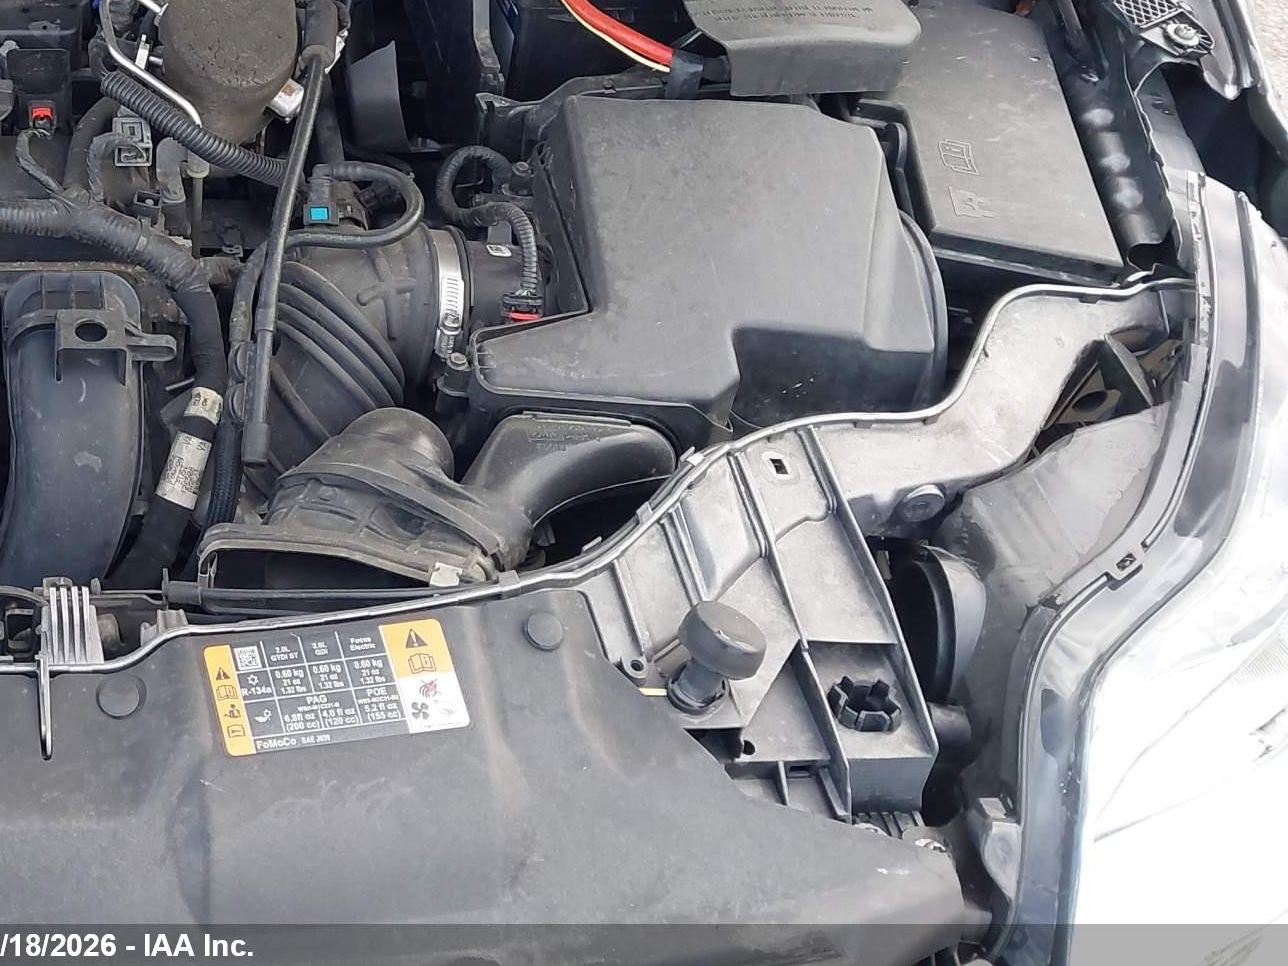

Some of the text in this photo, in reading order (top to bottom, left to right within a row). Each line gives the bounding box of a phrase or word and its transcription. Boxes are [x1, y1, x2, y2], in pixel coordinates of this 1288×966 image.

[275, 646, 290, 654] 2.0L
[350, 643, 376, 651] Electric
[271, 652, 298, 662] GTDI ST
[312, 664, 342, 674] 0.60 kg
[354, 659, 383, 669] 0.60 kg
[276, 669, 304, 679] 0.60 kg
[242, 686, 272, 697] R-134a
[367, 687, 388, 696] POE
[306, 695, 328, 704] PAG
[364, 704, 378, 712] 5.2
[379, 703, 386, 711] fl
[322, 710, 334, 718] 4.0
[337, 708, 344, 716] fl
[368, 710, 402, 722] (155 cc)
[286, 720, 320, 732] (200 cc)
[325, 716, 360, 727] (120 cc)
[256, 738, 296, 750] FoMoCo
[301, 736, 314, 744] SAE
